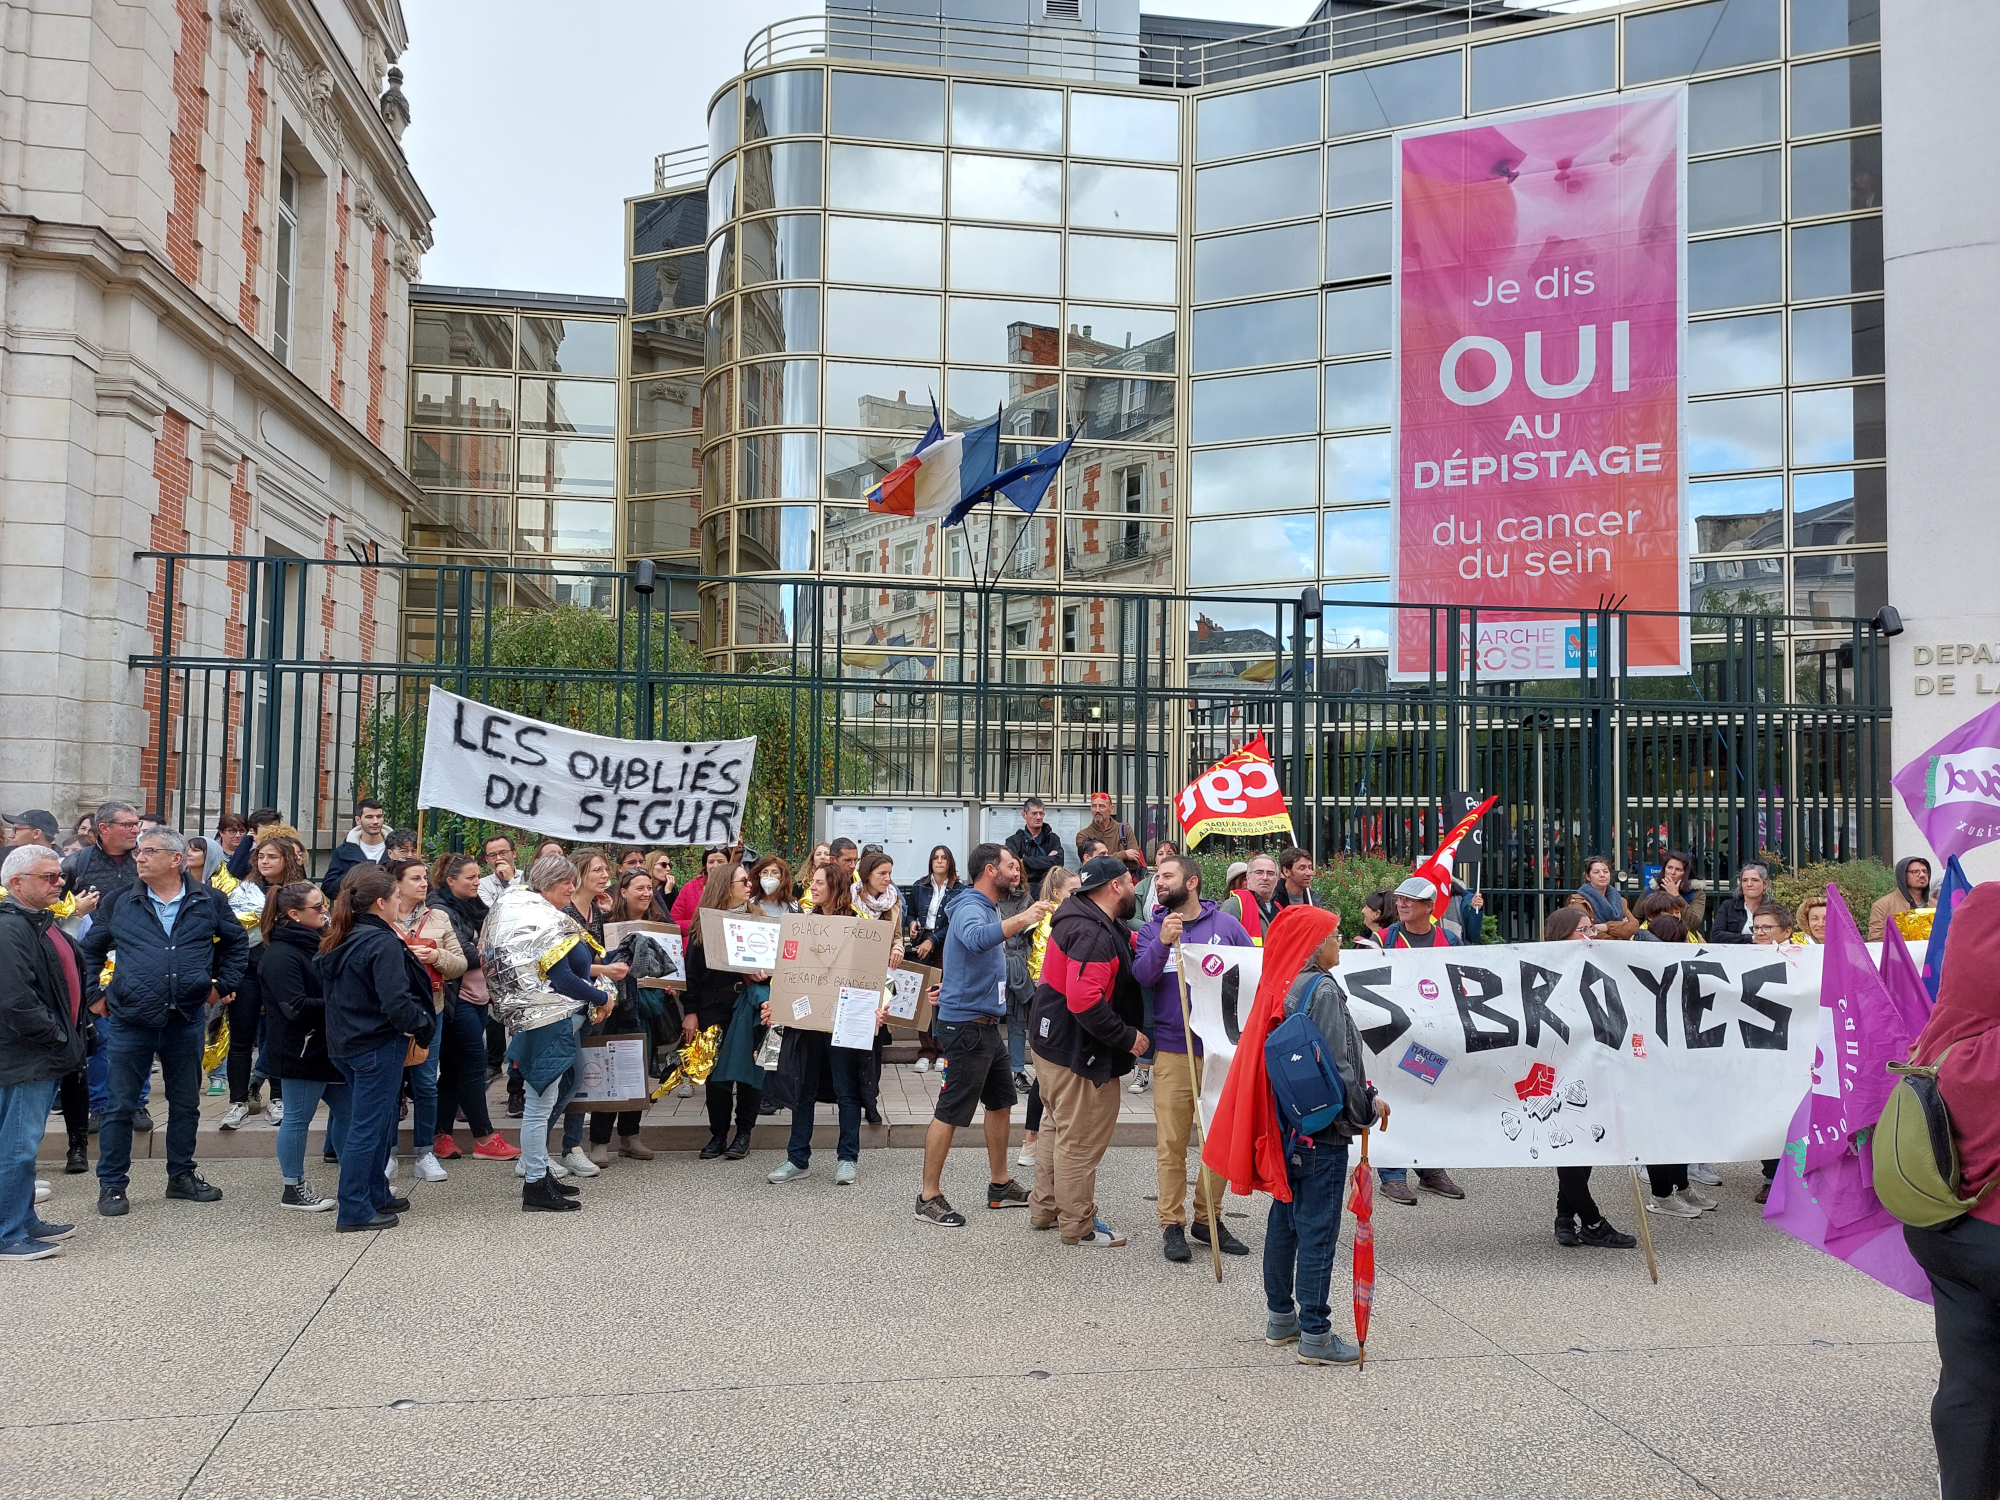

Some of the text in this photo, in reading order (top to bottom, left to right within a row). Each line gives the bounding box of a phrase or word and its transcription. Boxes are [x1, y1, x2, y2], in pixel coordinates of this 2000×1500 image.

[1472, 265, 1595, 308] Je dis
[1439, 320, 1630, 406] OUI
[1504, 413, 1561, 441] AU
[1414, 442, 1662, 489] DÉPISTAGE
[1432, 509, 1642, 546] du cancer
[1458, 542, 1612, 580] du sein
[1914, 675, 1956, 696] DE
[453, 701, 547, 767] LES
[485, 774, 740, 843] DU SEGUR
[791, 922, 830, 938] BLACK
[817, 943, 838, 955] DAY
[1445, 948, 1793, 1053] BROYÉS
[1411, 1045, 1445, 1066] MARCHE
